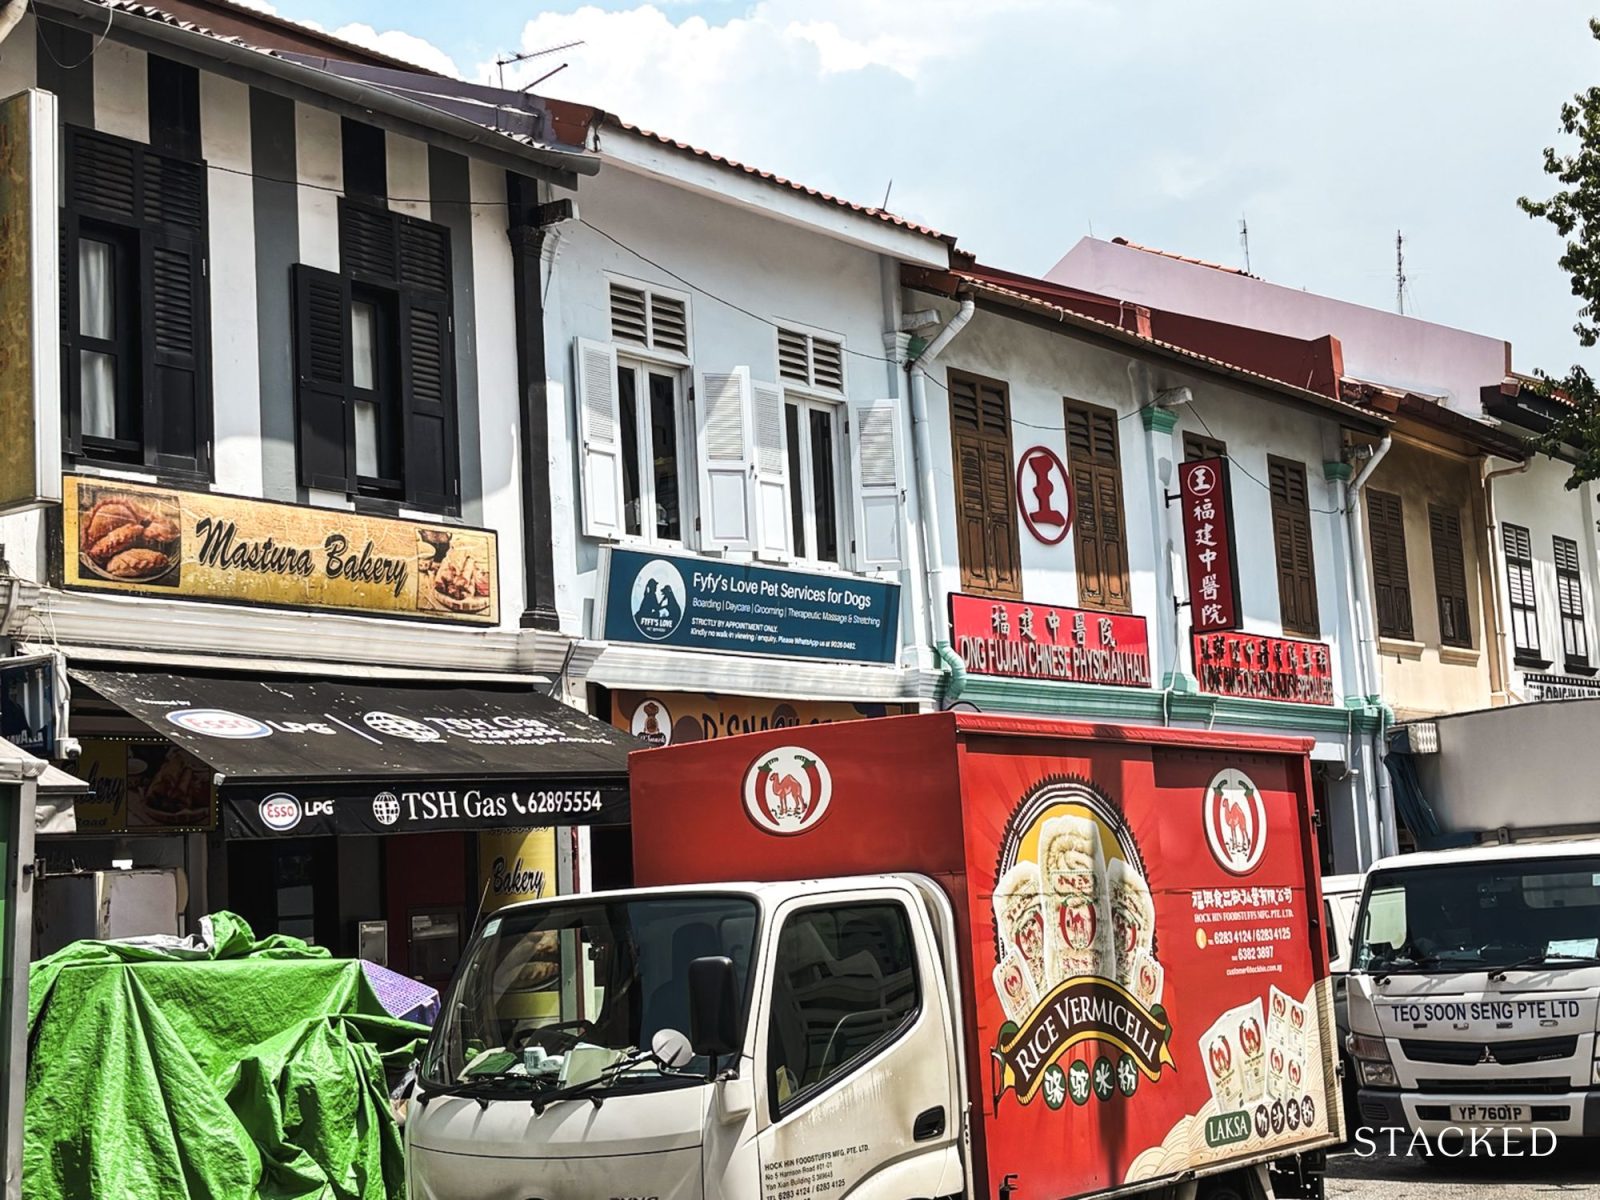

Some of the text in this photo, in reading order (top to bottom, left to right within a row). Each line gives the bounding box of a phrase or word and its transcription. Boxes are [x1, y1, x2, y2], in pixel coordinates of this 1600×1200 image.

[195, 517, 410, 598] Mastura Bakery
[1193, 499, 1227, 626] 福建中醫院
[693, 572, 871, 610] Fyfy's Love Pet Services for Dogs
[660, 619, 673, 628] LOVE
[692, 597, 722, 612] Boarding
[725, 601, 751, 613] Daycare
[754, 604, 784, 618] Grooming
[788, 608, 822, 620] Therapeutic
[823, 612, 847, 624] Massage
[853, 615, 880, 627] Stretching
[691, 617, 717, 626] STRICTLY
[725, 621, 764, 632] APPOINTMENT
[691, 628, 708, 637] Kindly
[991, 604, 1117, 647] 福建中醫院
[960, 635, 986, 669] ONG
[988, 638, 1028, 673] FUJIAN
[1028, 641, 1073, 677] CHINESE
[1073, 646, 1126, 682] PHYSICIAN
[265, 720, 336, 735] LPG
[424, 715, 548, 730] TSH Gas
[304, 799, 334, 817] LPG
[402, 790, 603, 821] TSH Gas 62895554
[492, 857, 545, 900] Bakery
[1213, 931, 1233, 945] 6283
[1233, 929, 1252, 943] 4124
[1255, 928, 1274, 942] 6283
[1273, 927, 1291, 940] 4125
[1391, 1000, 1580, 1022] TEO SOON SENG PTE LTD
[1014, 996, 1158, 1082] RICE VERMICELLI
[1208, 1115, 1249, 1142] LAKSA
[764, 1160, 783, 1171] HOCK
[783, 1159, 795, 1167] HIN
[795, 1152, 831, 1165] FOODSTUFFS
[858, 1144, 870, 1152] LTD.
[802, 1165, 815, 1173] Road
[778, 1189, 794, 1200] 6283
[795, 1186, 810, 1196] 4124
[816, 1182, 830, 1192] 6283
[831, 1178, 846, 1188] 4125
[790, 1177, 811, 1186] Building
